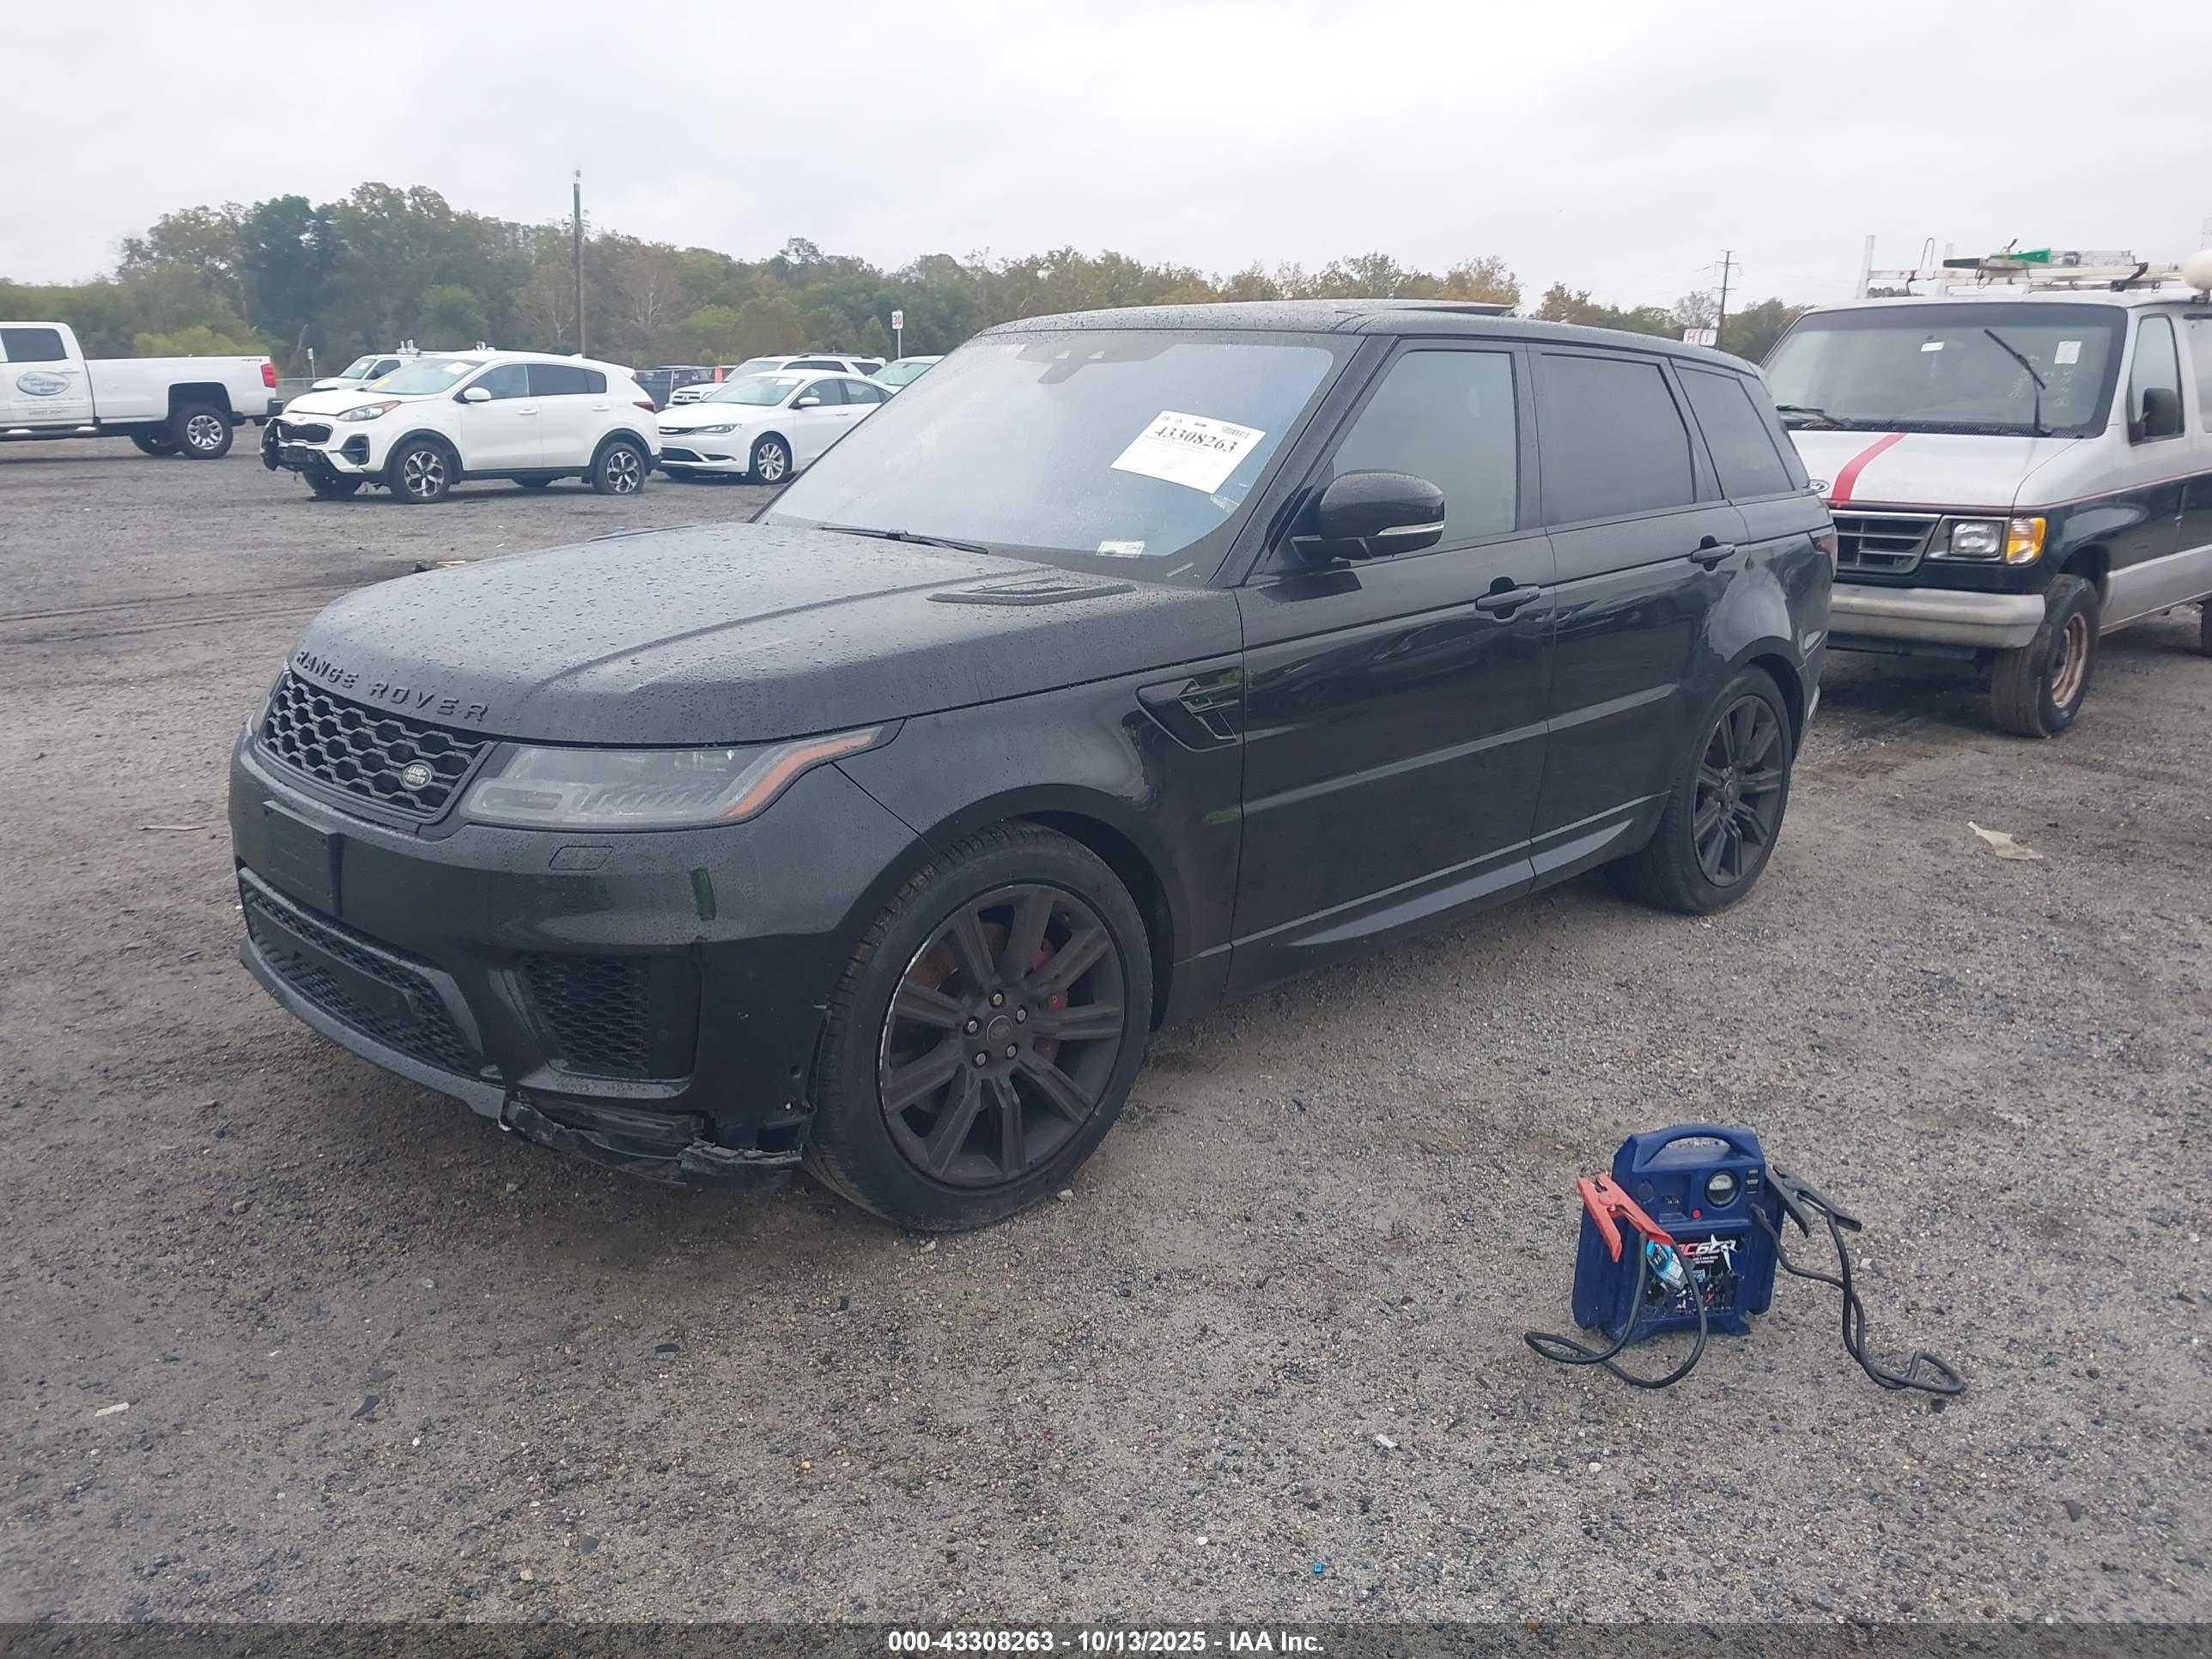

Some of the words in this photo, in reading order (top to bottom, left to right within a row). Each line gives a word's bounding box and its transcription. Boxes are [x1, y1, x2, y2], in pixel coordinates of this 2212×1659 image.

[893, 315, 902, 325] 30
[1154, 426, 1238, 453] 43308263
[296, 651, 359, 689] RANGE
[369, 683, 489, 721] ROVER
